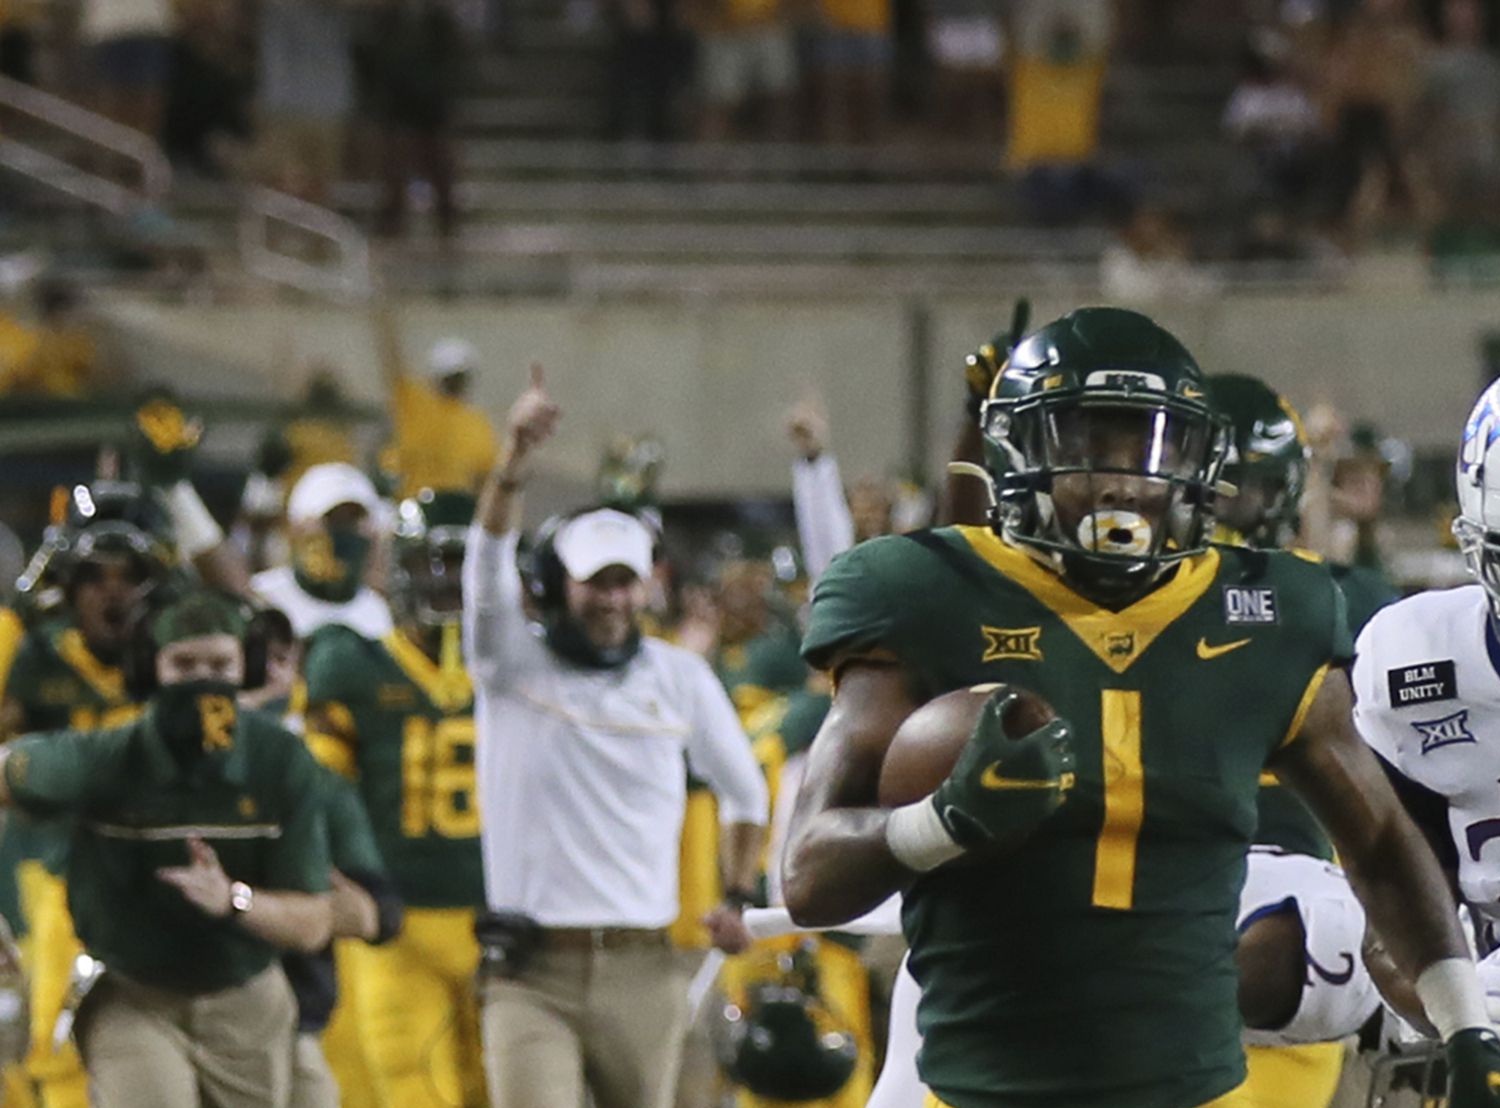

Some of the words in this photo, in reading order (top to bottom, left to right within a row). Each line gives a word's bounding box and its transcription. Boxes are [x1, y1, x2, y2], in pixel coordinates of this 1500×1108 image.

[1226, 588, 1275, 615] ONE
[1404, 666, 1436, 683] BLM
[1399, 682, 1445, 701] UNITY
[1092, 689, 1142, 910] 1
